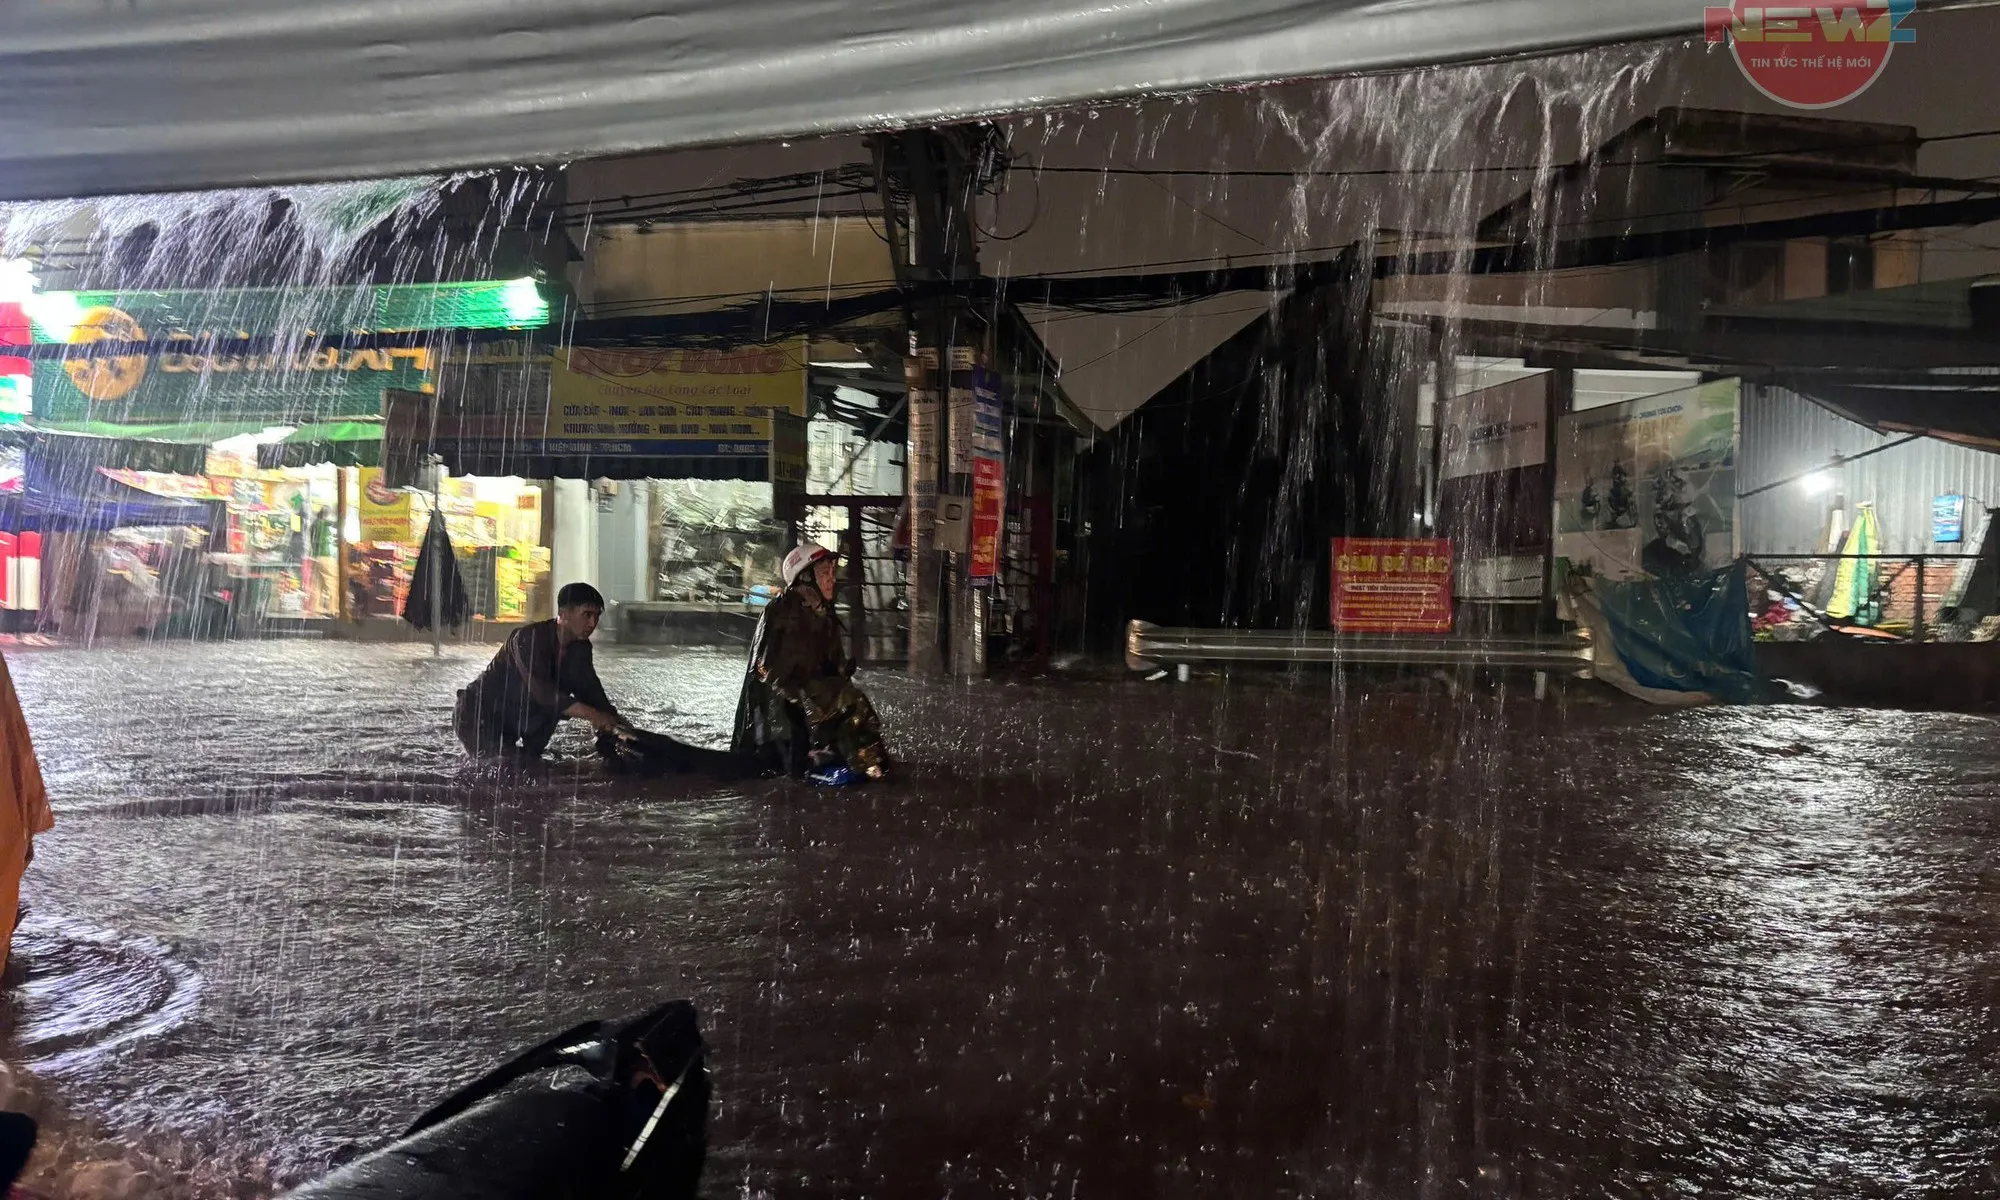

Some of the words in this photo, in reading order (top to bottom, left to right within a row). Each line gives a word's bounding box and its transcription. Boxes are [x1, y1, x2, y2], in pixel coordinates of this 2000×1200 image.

[1336, 548, 1378, 573] CẤM
[1381, 548, 1406, 573] ĐỔ
[1411, 549, 1449, 573] RÁC
